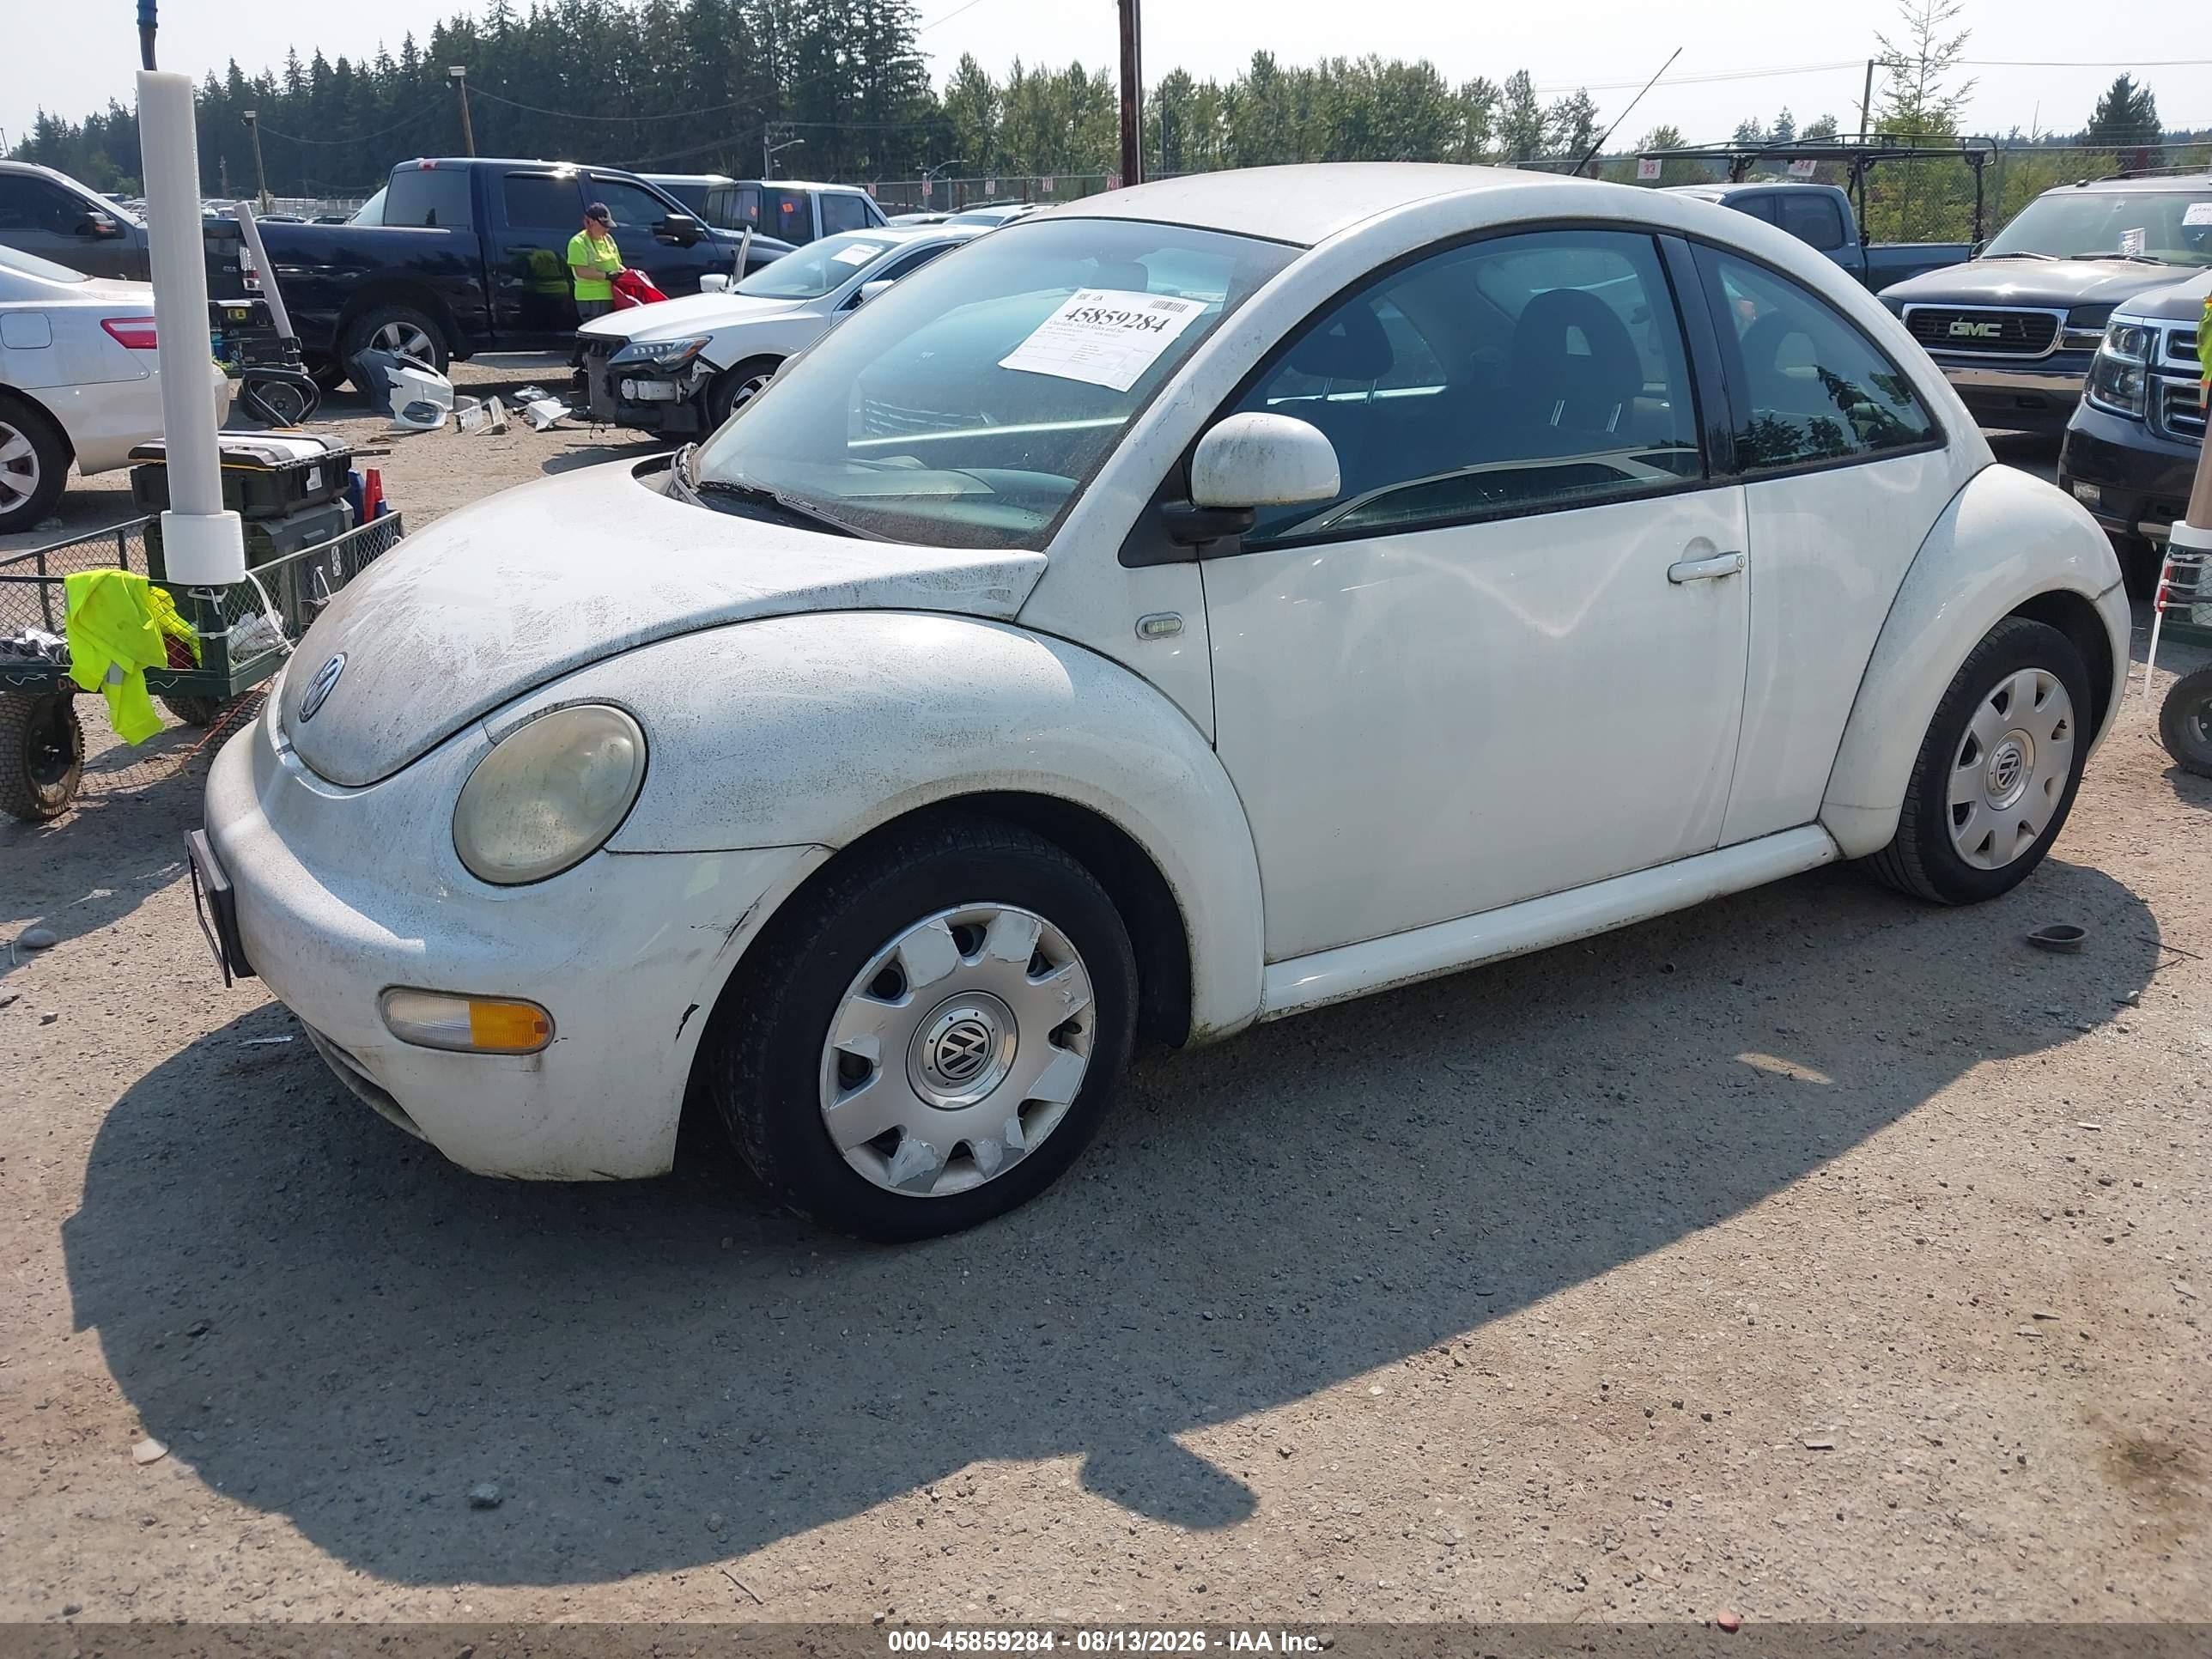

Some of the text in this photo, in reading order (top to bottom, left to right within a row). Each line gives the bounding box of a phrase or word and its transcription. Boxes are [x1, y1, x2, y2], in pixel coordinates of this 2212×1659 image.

[1643, 163, 1656, 174] 33
[1064, 306, 1171, 334] 45859284
[1949, 321, 2002, 337] GMC
